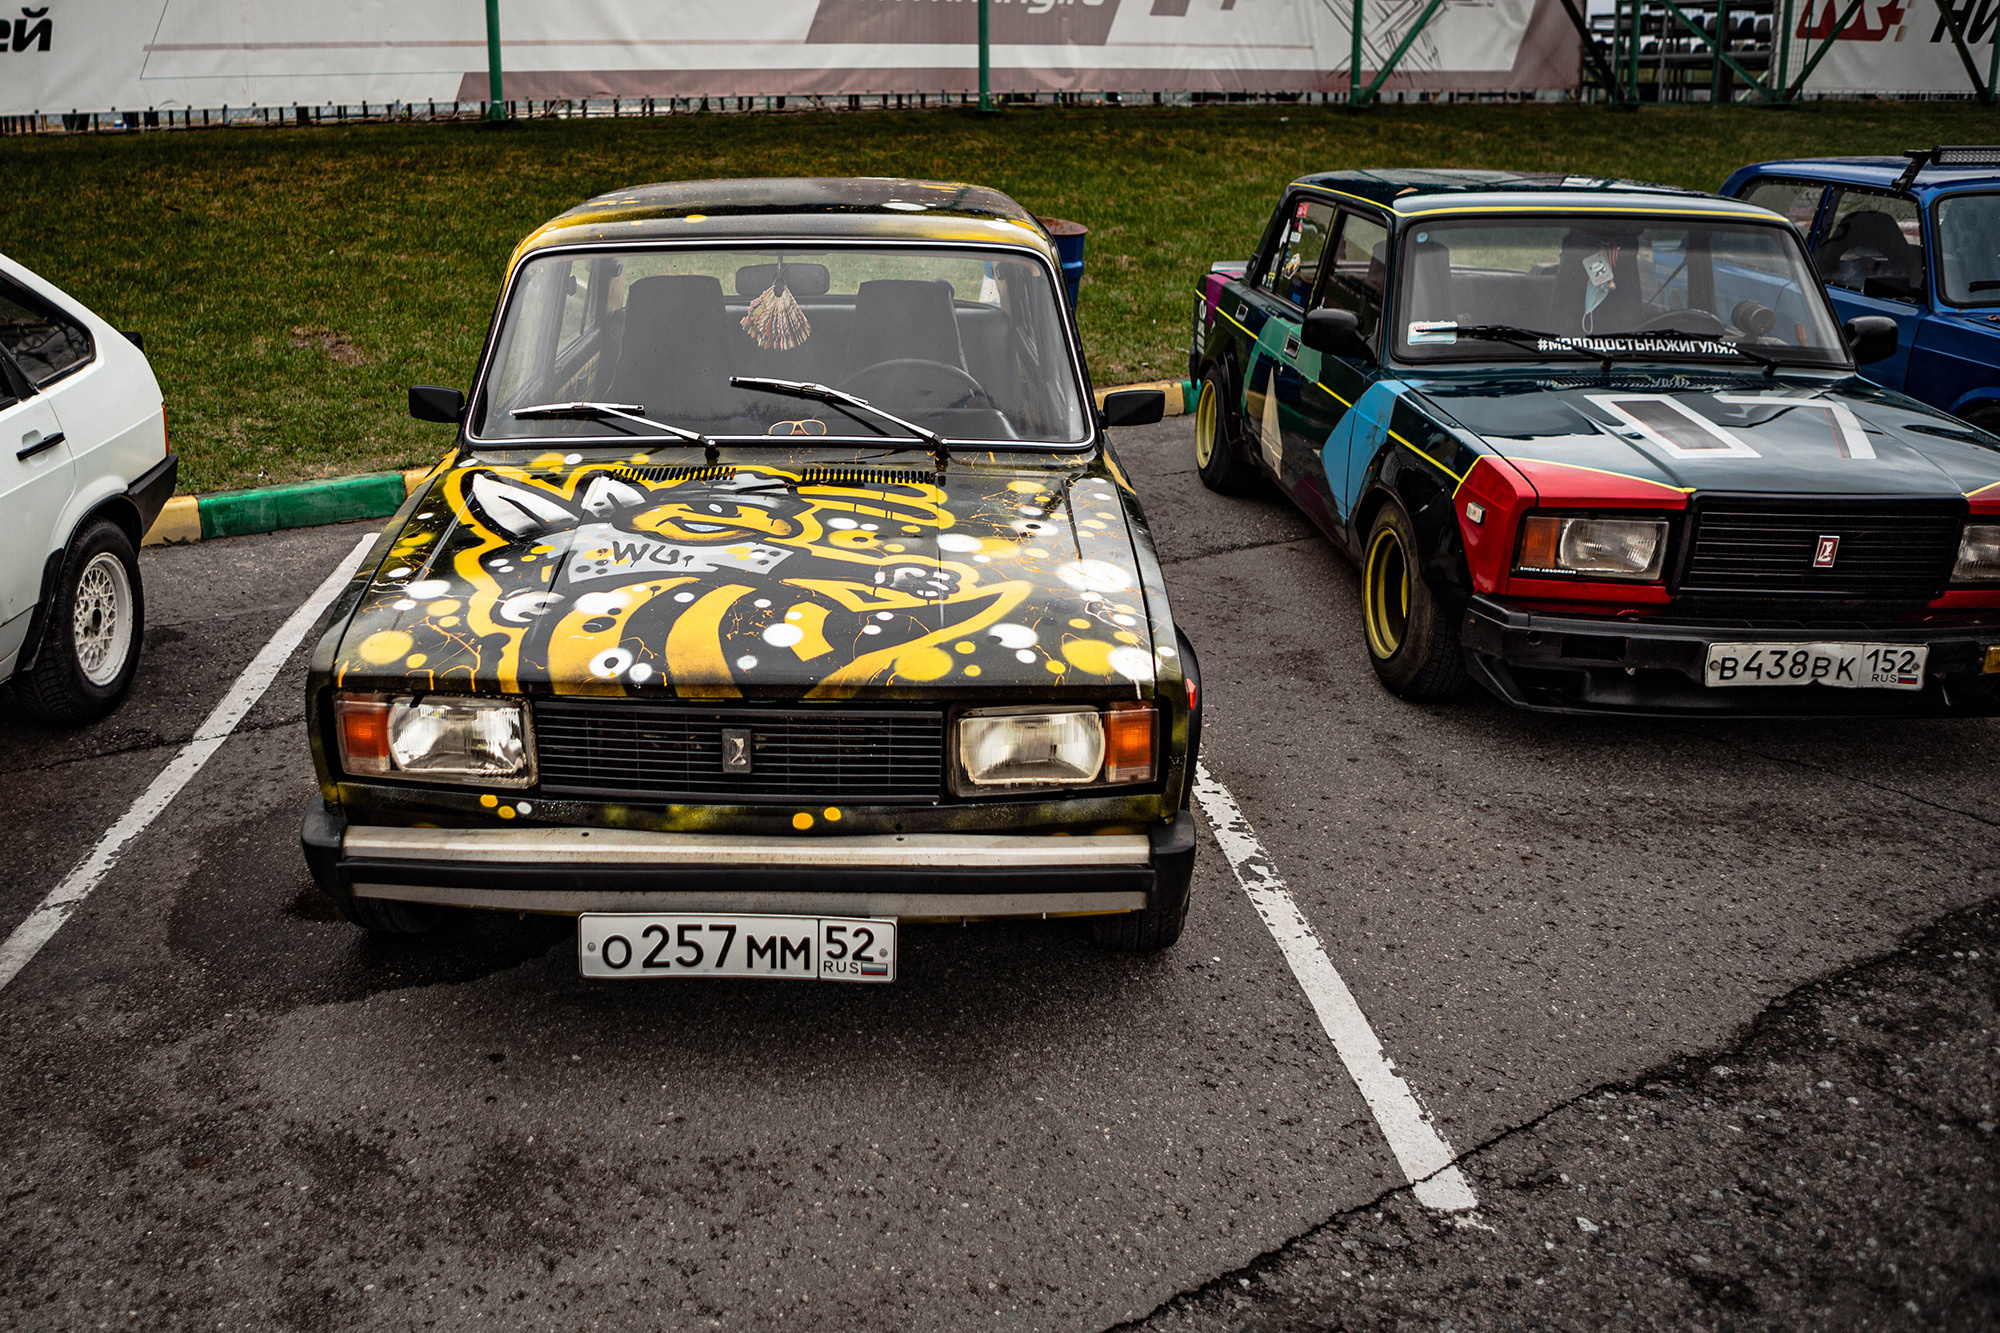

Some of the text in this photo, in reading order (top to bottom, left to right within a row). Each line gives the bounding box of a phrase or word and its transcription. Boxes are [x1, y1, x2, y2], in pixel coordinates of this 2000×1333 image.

[1866, 649, 1916, 674] 152
[1870, 673, 1898, 683] RUS
[826, 925, 875, 962] 52
[823, 960, 860, 974] RUS
